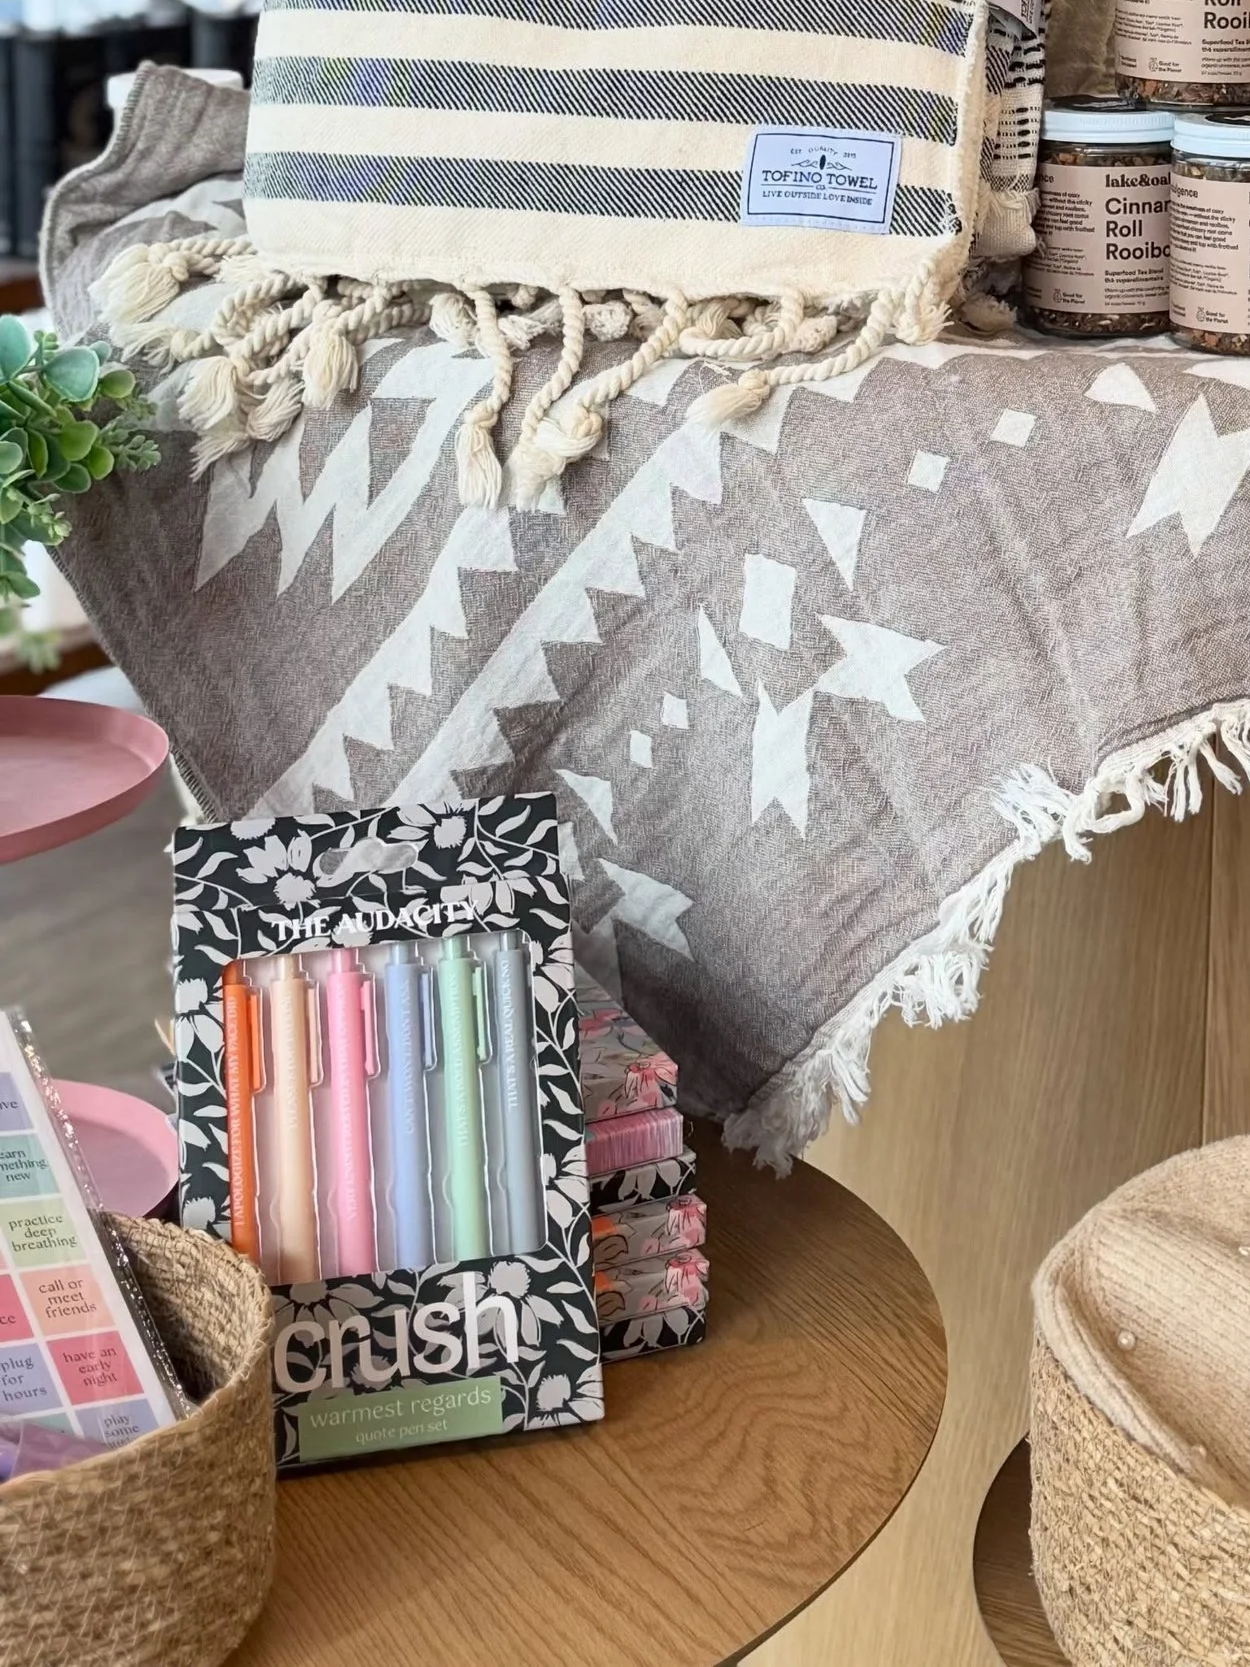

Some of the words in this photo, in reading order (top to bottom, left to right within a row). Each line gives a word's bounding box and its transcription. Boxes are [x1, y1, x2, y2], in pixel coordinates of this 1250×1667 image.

[762, 170, 822, 184] TOFINO
[826, 173, 878, 190] TOWEL
[762, 190, 783, 198] LIVE
[784, 191, 821, 200] OUTSIDE
[822, 194, 846, 203] LOVE
[846, 195, 873, 206] INSIDE
[1105, 219, 1143, 238] Roll
[271, 915, 332, 941] THE
[332, 900, 479, 936] AUDACITY
[501, 960, 511, 979] NO
[227, 997, 238, 1018] DID
[502, 980, 516, 1019] QUICK
[228, 1019, 239, 1052] FACE
[503, 1023, 515, 1053] REAL
[229, 1054, 240, 1074] MY
[229, 1077, 241, 1118] WHAT
[506, 1066, 519, 1110] THAT'S
[230, 1121, 242, 1145] FOR
[6, 1172, 31, 1182] new
[230, 1146, 245, 1219] APOLOGIZE
[8, 1214, 63, 1231] practice
[24, 1226, 57, 1239] deep
[12, 1236, 78, 1253] breathing
[38, 1279, 66, 1294] call
[67, 1279, 84, 1289] or
[48, 1291, 85, 1305] meet
[45, 1302, 97, 1319] friends
[273, 1271, 520, 1393] crush
[63, 1351, 95, 1363] have
[100, 1346, 118, 1358] an
[1, 1357, 34, 1373] plug
[78, 1359, 111, 1375] early
[83, 1372, 118, 1387] night
[2, 1386, 48, 1402] hours
[310, 1400, 406, 1429] warmest
[411, 1386, 492, 1417] regards
[104, 1415, 129, 1428] play
[105, 1425, 140, 1437] some
[355, 1427, 396, 1445] quote
[400, 1423, 424, 1441] pen
[427, 1419, 448, 1433] set
